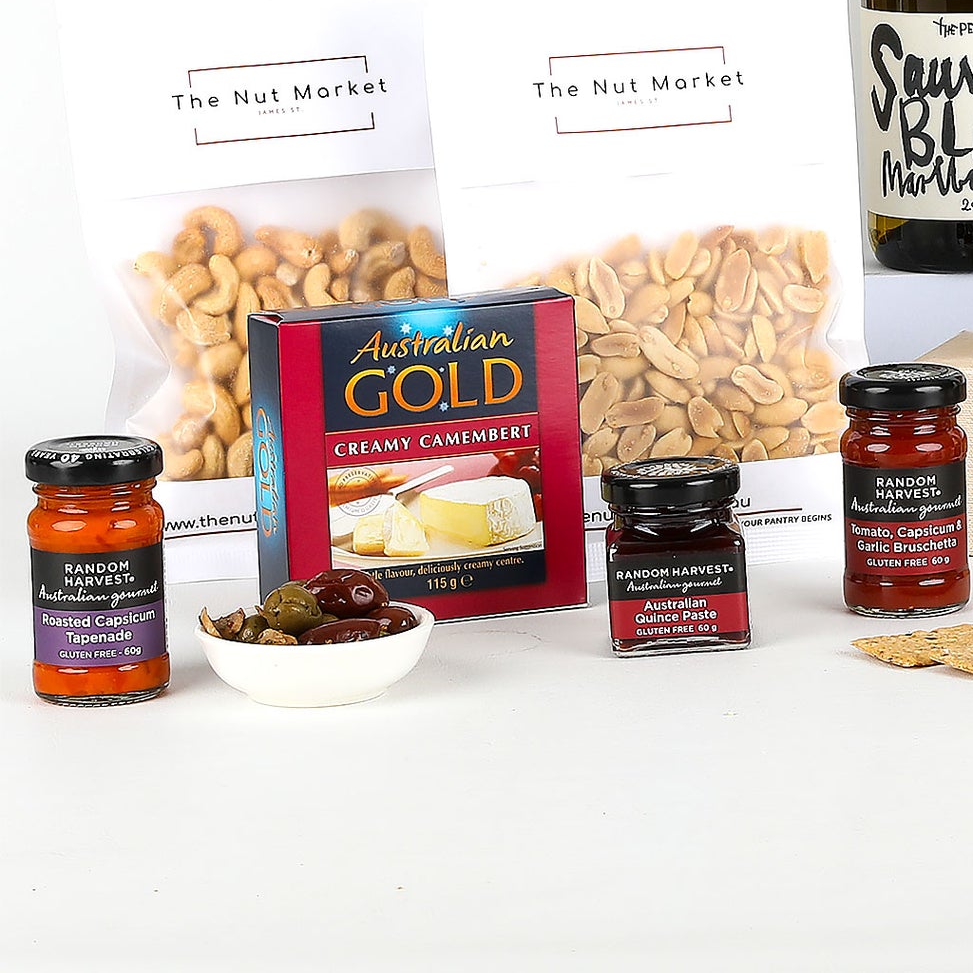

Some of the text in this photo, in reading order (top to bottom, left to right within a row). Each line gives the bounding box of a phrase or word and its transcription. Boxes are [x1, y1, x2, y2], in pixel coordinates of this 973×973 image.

[532, 71, 744, 98] The Nut Market
[172, 78, 388, 110] The Nut Market
[350, 322, 514, 364] Australian
[345, 357, 523, 417] GOLD
[334, 424, 531, 457] CREAMY CAMEMBERT
[60, 453, 80, 463] 40
[876, 475, 936, 488] RANDOM
[850, 497, 918, 513] Australian
[741, 514, 832, 527] OUR PANTRY BEGINS
[850, 523, 893, 539] Tomato,
[897, 523, 954, 540] Capsicum
[857, 537, 958, 553] Garlic Bruschetta
[64, 560, 130, 574] RANDOM
[418, 562, 461, 576] deliciously
[463, 560, 494, 572] creamy
[866, 558, 901, 567] GLUTEN
[904, 557, 928, 567] FREE
[616, 568, 669, 580] RANDOM
[427, 577, 447, 590] 115
[450, 578, 457, 590] g
[38, 583, 110, 603] Australian
[644, 598, 707, 611] Australian
[42, 608, 156, 629] Roasted Capsicum
[635, 609, 717, 624] Quince Paste
[66, 630, 133, 646] Tapenade
[636, 627, 670, 636] GLUTEN
[672, 625, 694, 634] FREE
[59, 649, 92, 659] GLUTEN
[94, 649, 117, 658] FREE
[124, 646, 142, 657] 60g
